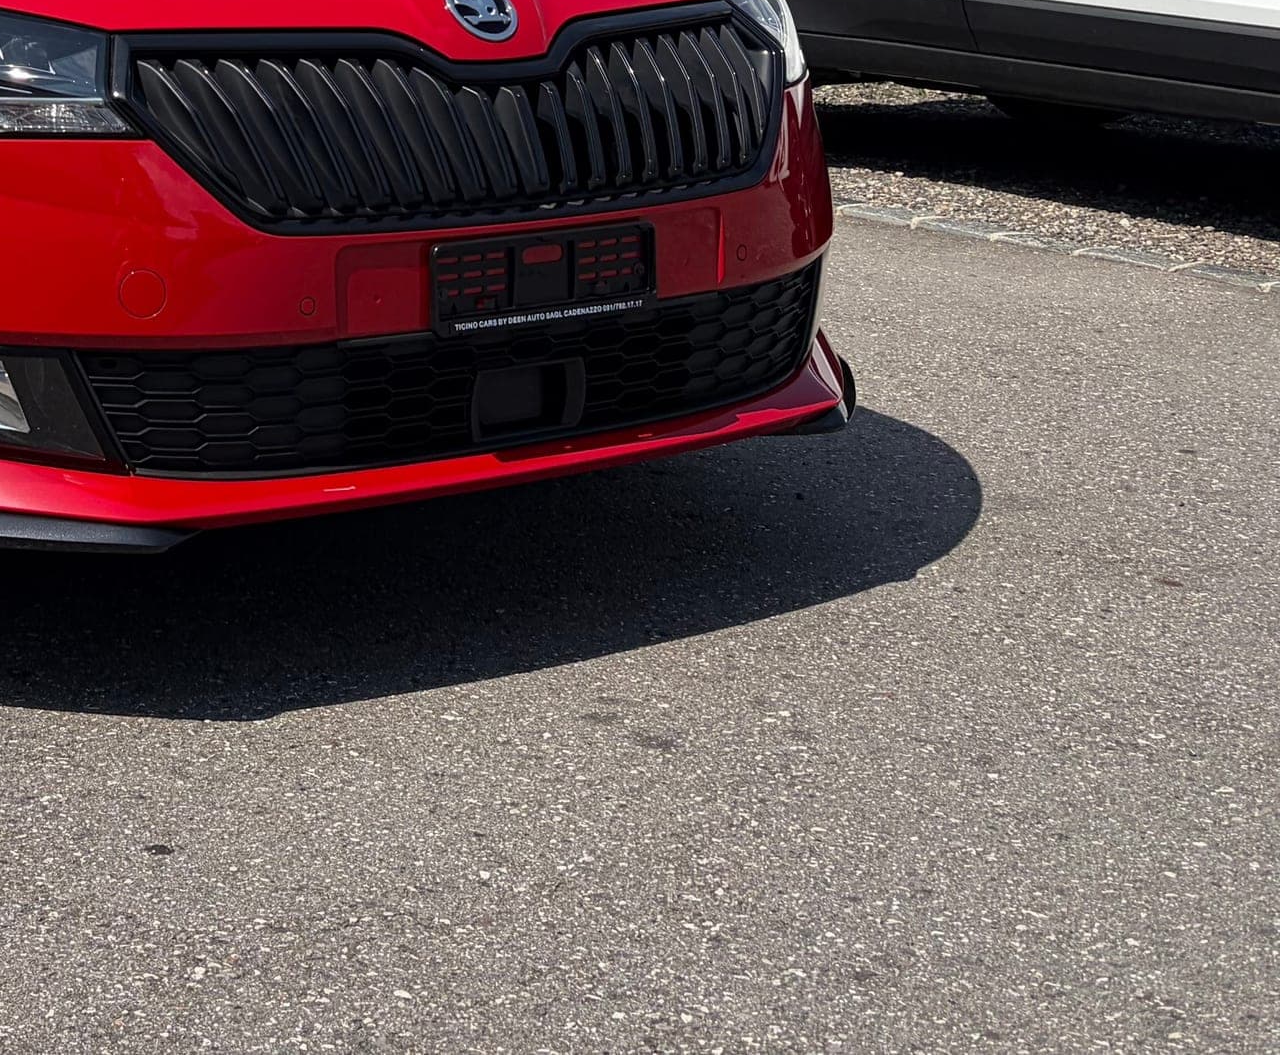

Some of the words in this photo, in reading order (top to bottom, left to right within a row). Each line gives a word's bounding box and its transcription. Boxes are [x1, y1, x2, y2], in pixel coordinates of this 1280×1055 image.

[455, 321, 479, 331] TICINO
[479, 318, 498, 328] CARS
[498, 316, 508, 326] BY
[527, 312, 546, 322] AUTO
[563, 306, 602, 317] CADENAZZO
